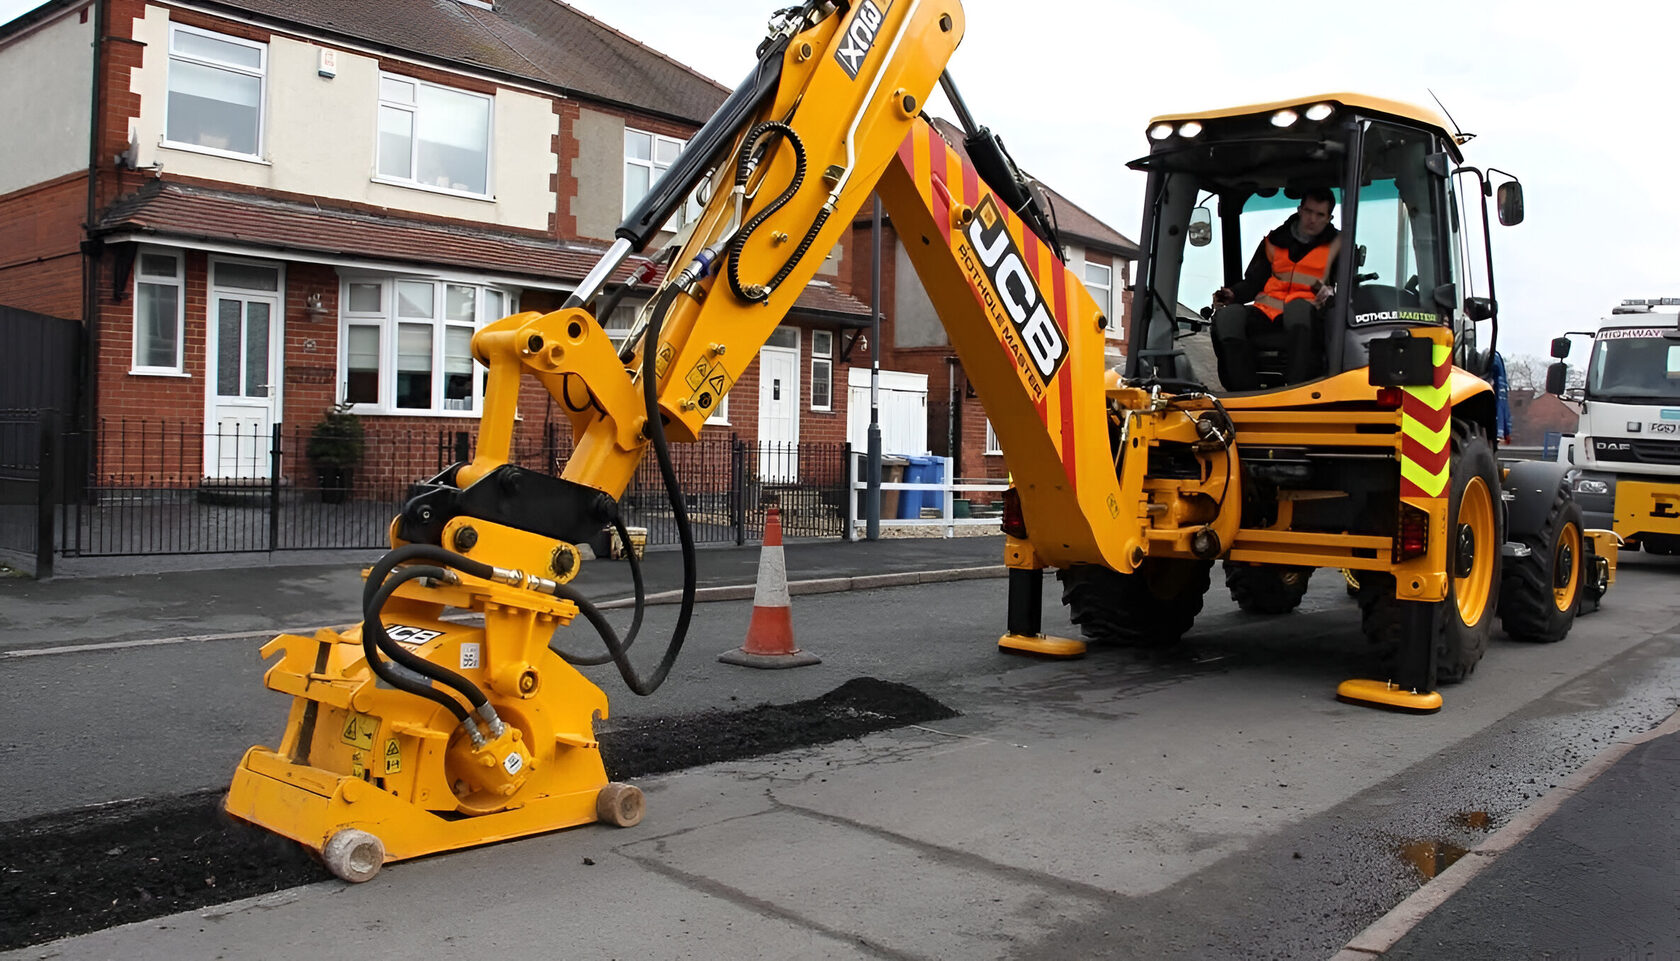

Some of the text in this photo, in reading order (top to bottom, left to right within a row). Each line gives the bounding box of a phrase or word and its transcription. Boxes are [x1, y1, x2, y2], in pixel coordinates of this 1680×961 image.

[958, 244, 1043, 399] POTHOLE MASTER
[969, 218, 1063, 376] JCB
[1355, 311, 1399, 324] POTHOLE
